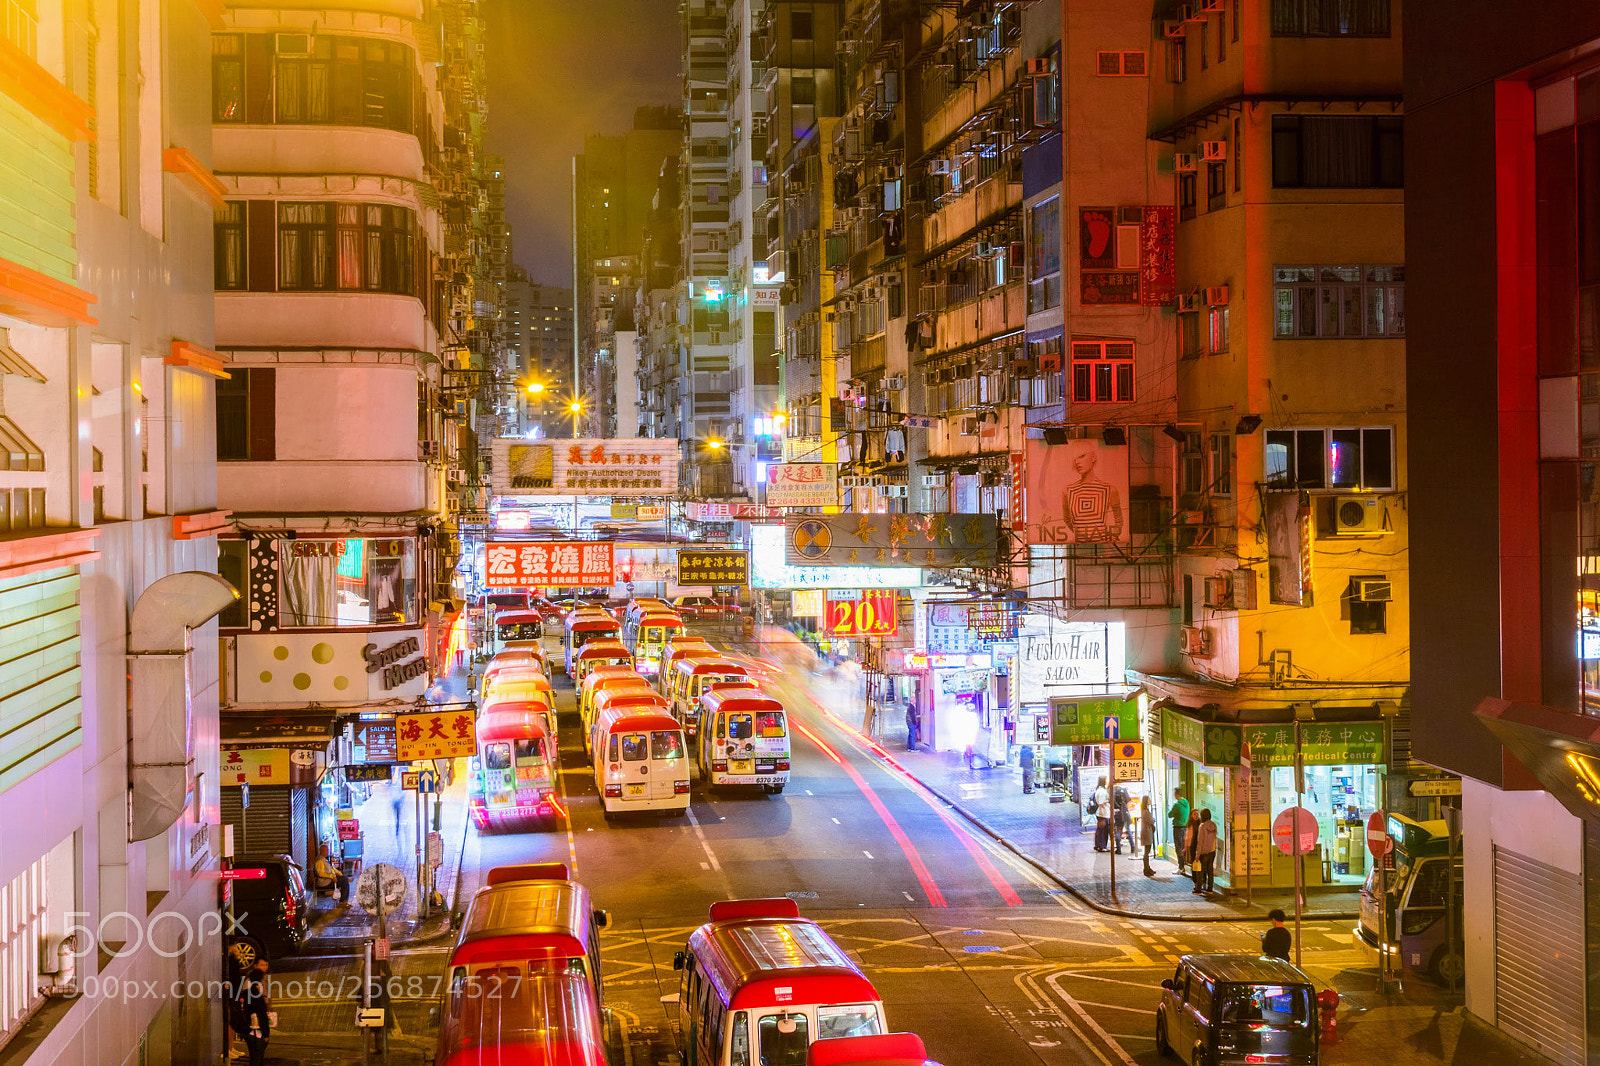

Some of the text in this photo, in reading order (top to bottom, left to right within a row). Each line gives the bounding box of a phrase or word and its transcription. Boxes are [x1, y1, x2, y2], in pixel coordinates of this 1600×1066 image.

[755, 291, 779, 299] 知足
[512, 474, 552, 488] Nikon
[1039, 525, 1068, 541] INS
[833, 601, 875, 632] 20
[1045, 667, 1081, 681] SALON
[399, 715, 473, 742] 海天堂
[1342, 751, 1377, 761] Centre
